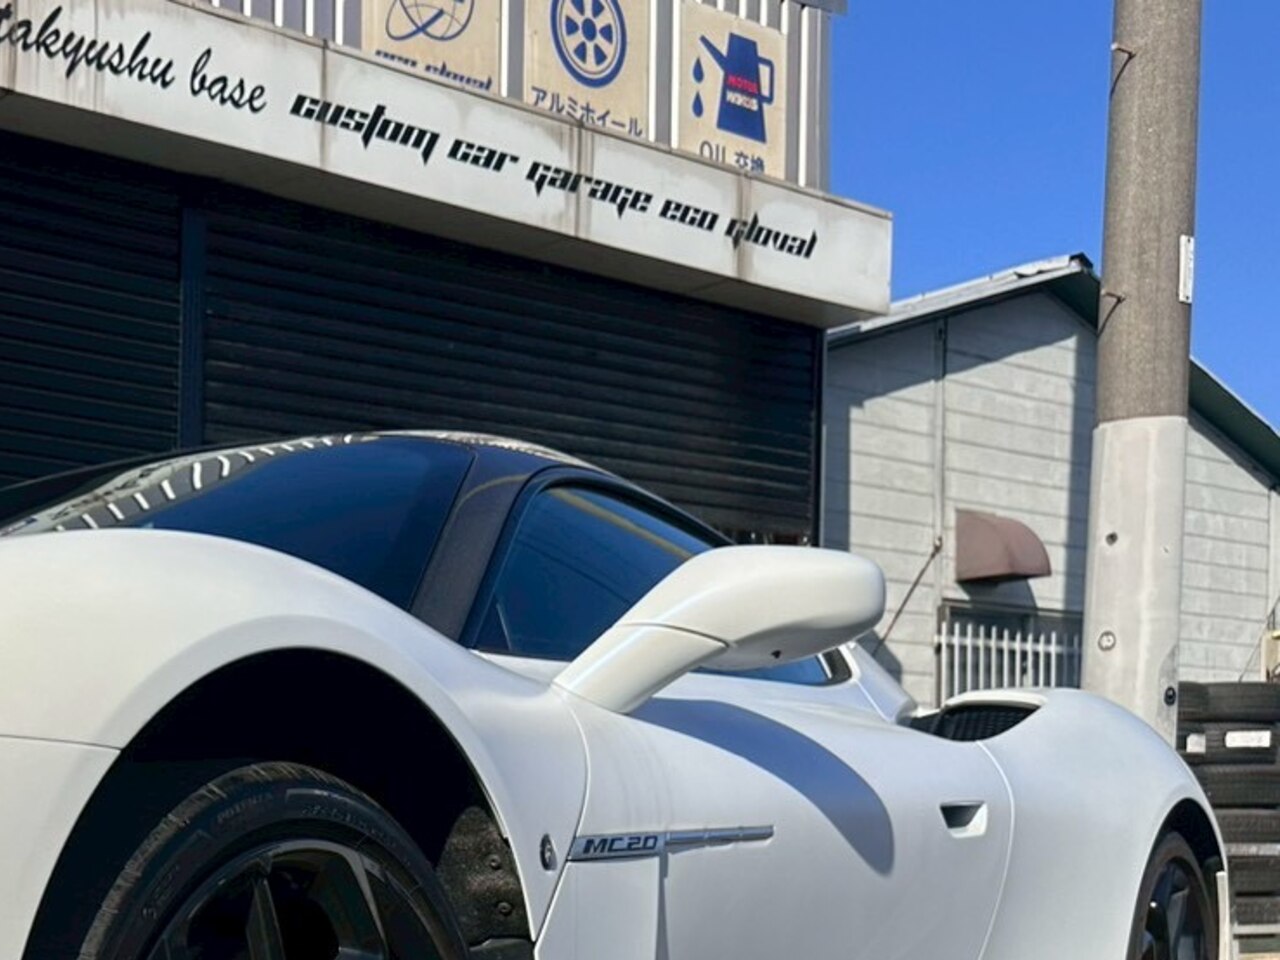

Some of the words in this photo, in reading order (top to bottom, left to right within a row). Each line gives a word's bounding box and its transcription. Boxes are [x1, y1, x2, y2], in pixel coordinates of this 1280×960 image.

[531, 85, 643, 137] アルミホイール
[190, 48, 267, 113] base
[289, 93, 440, 166] custom
[446, 138, 520, 173] car
[525, 160, 653, 219] garage
[658, 199, 719, 232] eco
[582, 835, 658, 855] MC20
